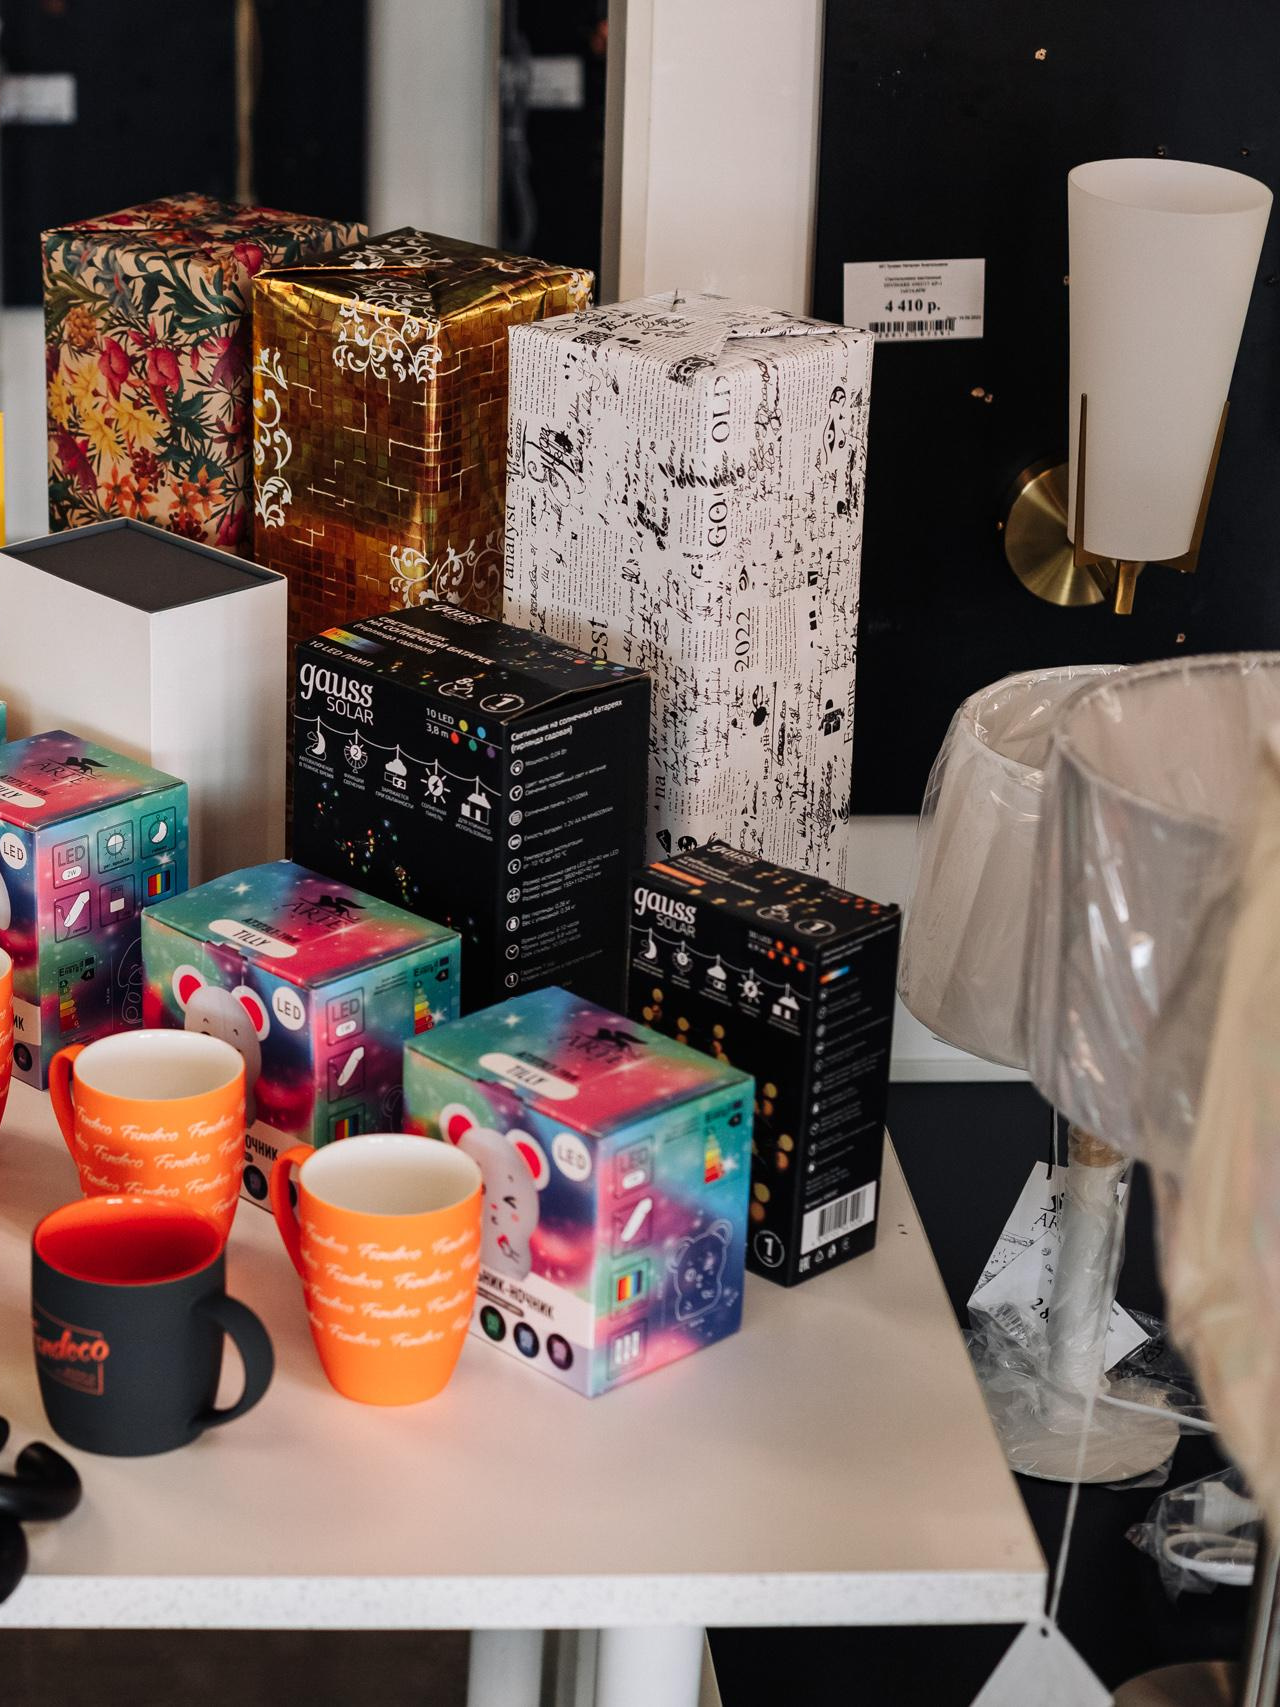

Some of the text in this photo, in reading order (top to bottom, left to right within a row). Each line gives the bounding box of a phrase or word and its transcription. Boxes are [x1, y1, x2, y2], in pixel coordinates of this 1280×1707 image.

[885, 300, 893, 312] 4
[898, 299, 923, 312] 410
[504, 503, 519, 575] analyst
[424, 602, 491, 626] gauss
[377, 615, 451, 642] СВЕТИЛЬНИК
[587, 616, 609, 661] est
[734, 608, 751, 673] 2022
[308, 639, 322, 652] 10
[323, 645, 344, 659] LED
[342, 652, 375, 668] ЛАМП
[366, 618, 384, 630] НА
[382, 622, 447, 650] СОЛНЕЧНОЙ
[445, 644, 498, 666] БАТАРЕЕ
[299, 662, 374, 708] gauss
[326, 697, 374, 726] SOLAR
[426, 707, 455, 726] 10 LED
[844, 680, 856, 744] Events
[426, 722, 449, 740] 3,8 m
[550, 721, 558, 730] на
[2, 844, 24, 862] LED
[56, 844, 86, 868] LED
[66, 868, 77, 879] 2W
[634, 886, 698, 924] gauss
[233, 929, 271, 948] TILLY
[656, 913, 697, 939] SOLAR
[276, 997, 302, 1021] LED
[330, 997, 360, 1022] LED
[506, 1064, 546, 1086] TILLY
[77, 1104, 112, 1136] Fandeco
[120, 1123, 180, 1143] Fandeco
[93, 1143, 212, 1170] Fandeco Fandeco
[245, 1134, 278, 1161] ОЧНИК
[556, 1144, 586, 1171] LED
[124, 1180, 181, 1199] Fandeco
